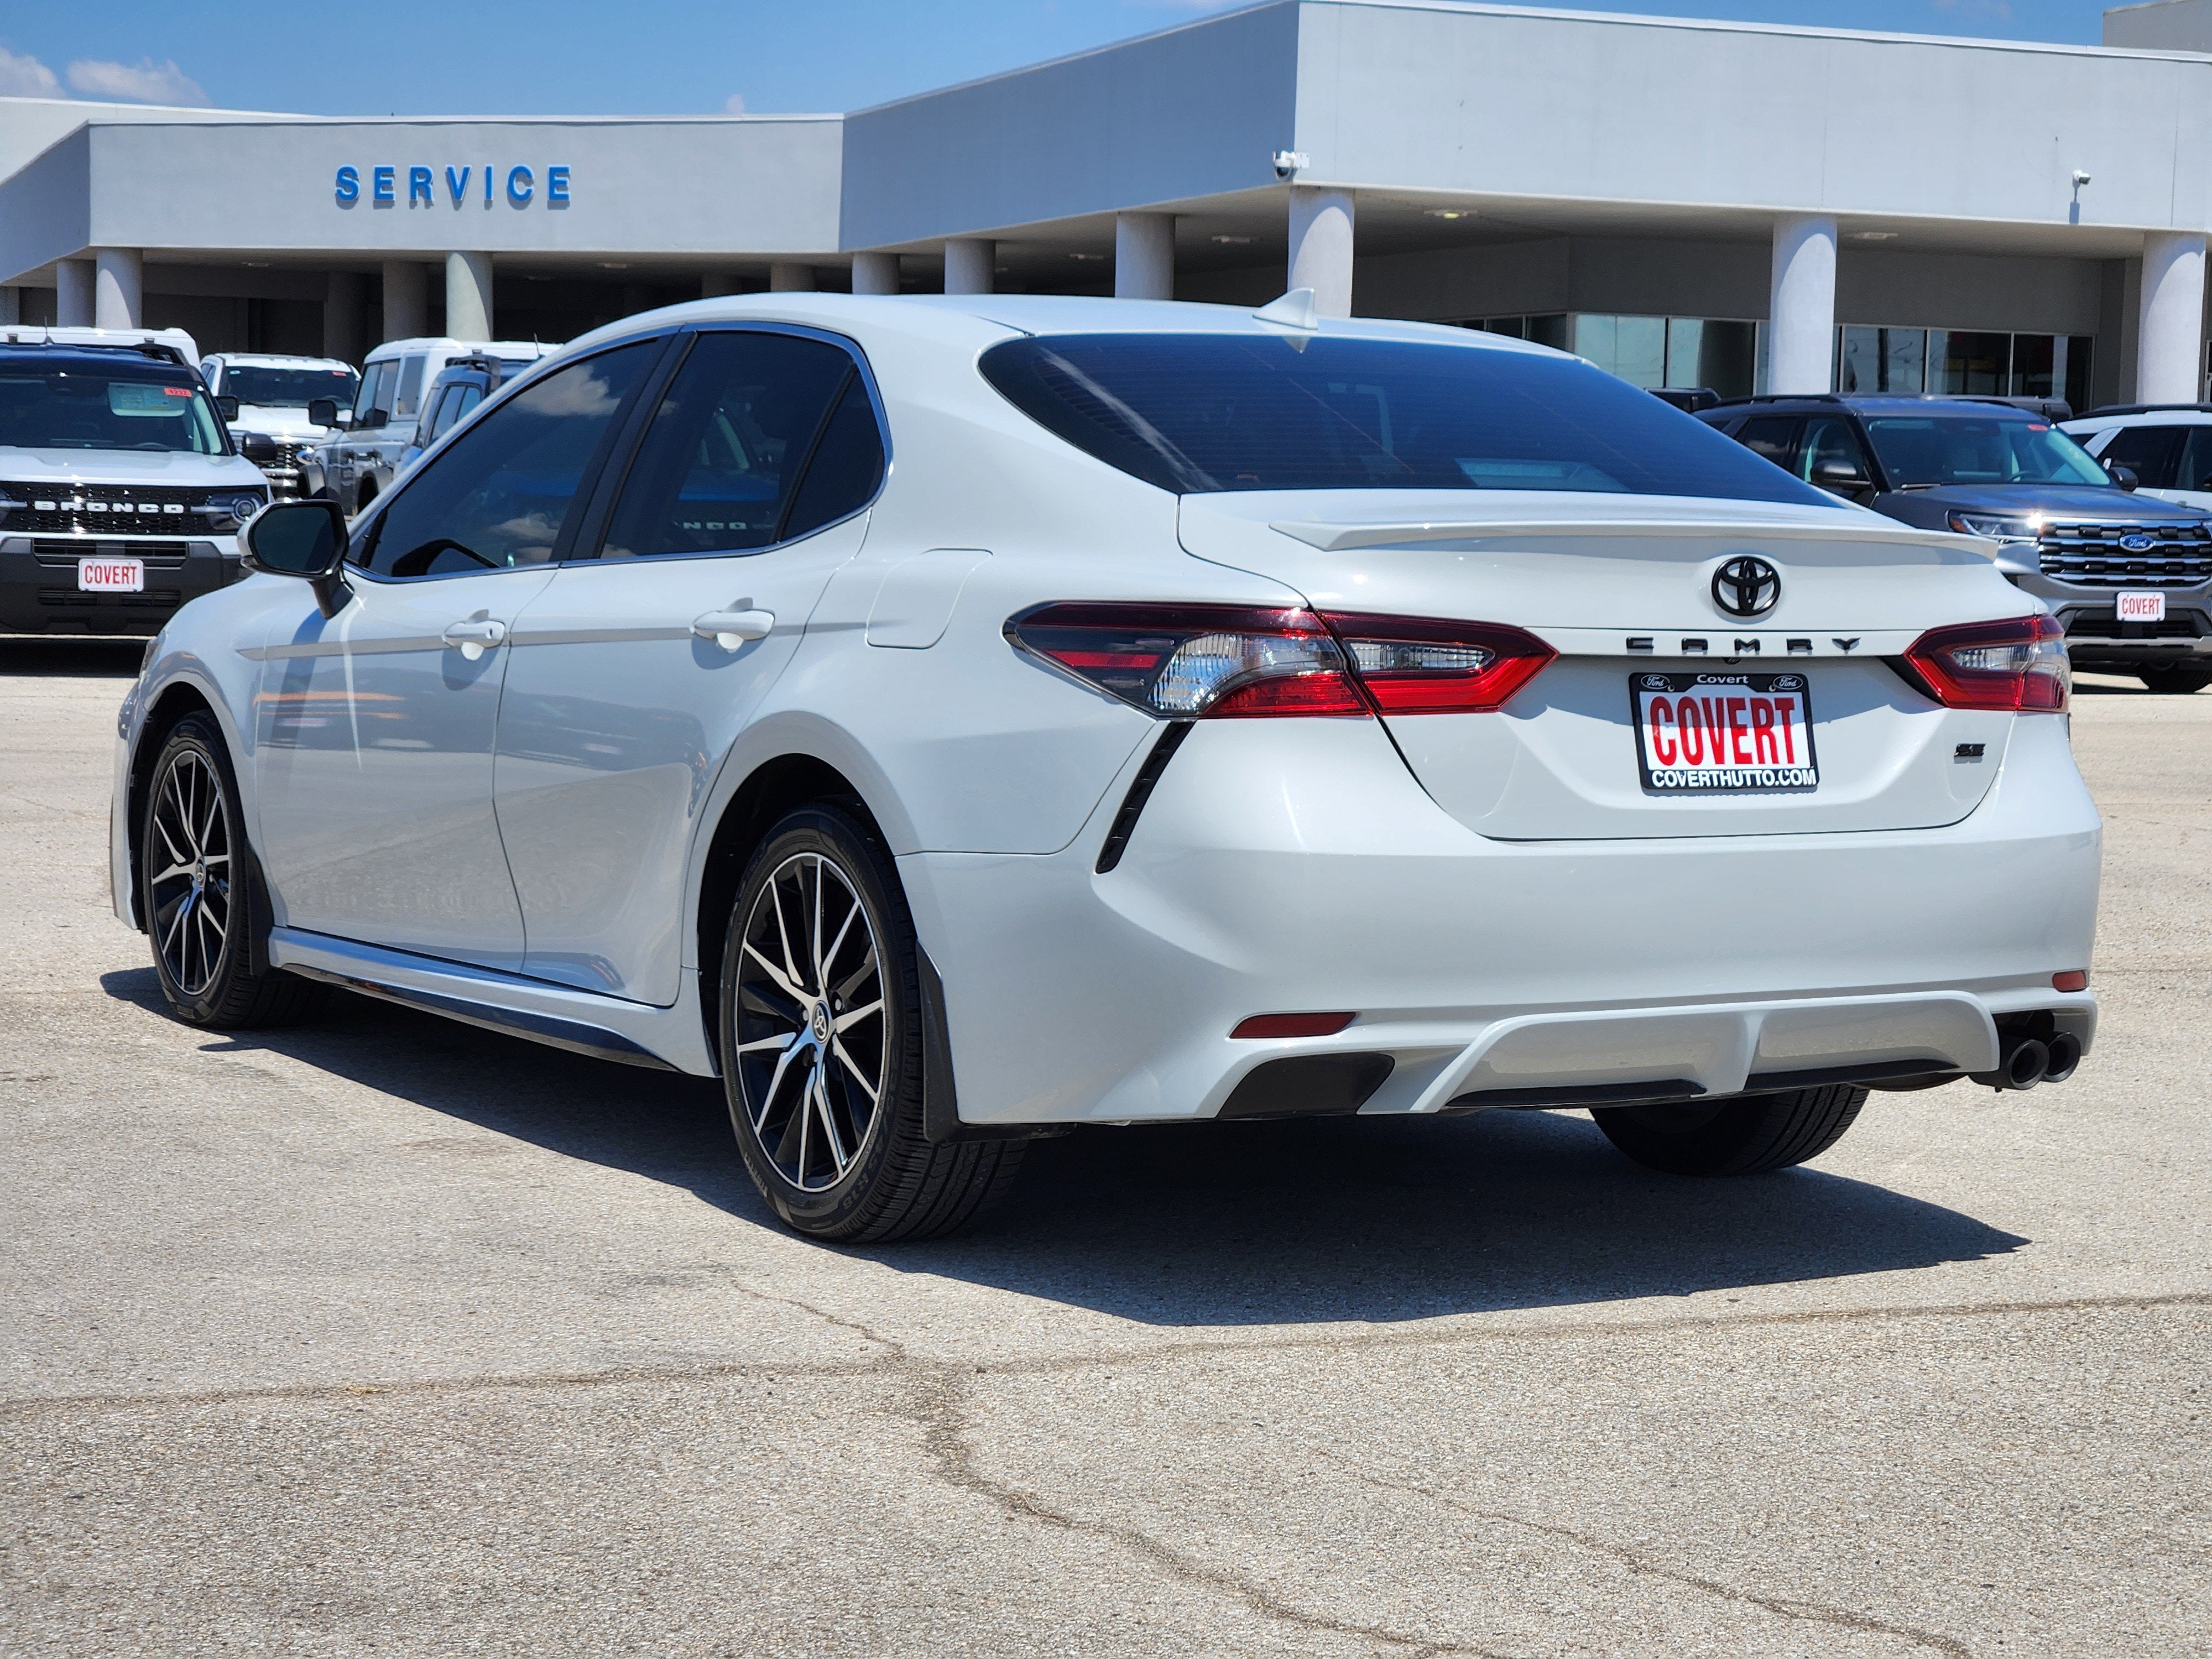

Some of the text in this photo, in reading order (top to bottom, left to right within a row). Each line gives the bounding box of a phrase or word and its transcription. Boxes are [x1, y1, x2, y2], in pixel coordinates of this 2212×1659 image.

[335, 164, 571, 202] SERVICE
[34, 500, 185, 514] BRONCO
[84, 565, 138, 585] COVERT
[2122, 597, 2161, 615] COVERT
[1626, 637, 1861, 651] CAMRY
[1697, 674, 1750, 685] Covert
[1650, 696, 1796, 766] COVERT
[1651, 768, 1817, 787] COVERTHUTTO.COM
